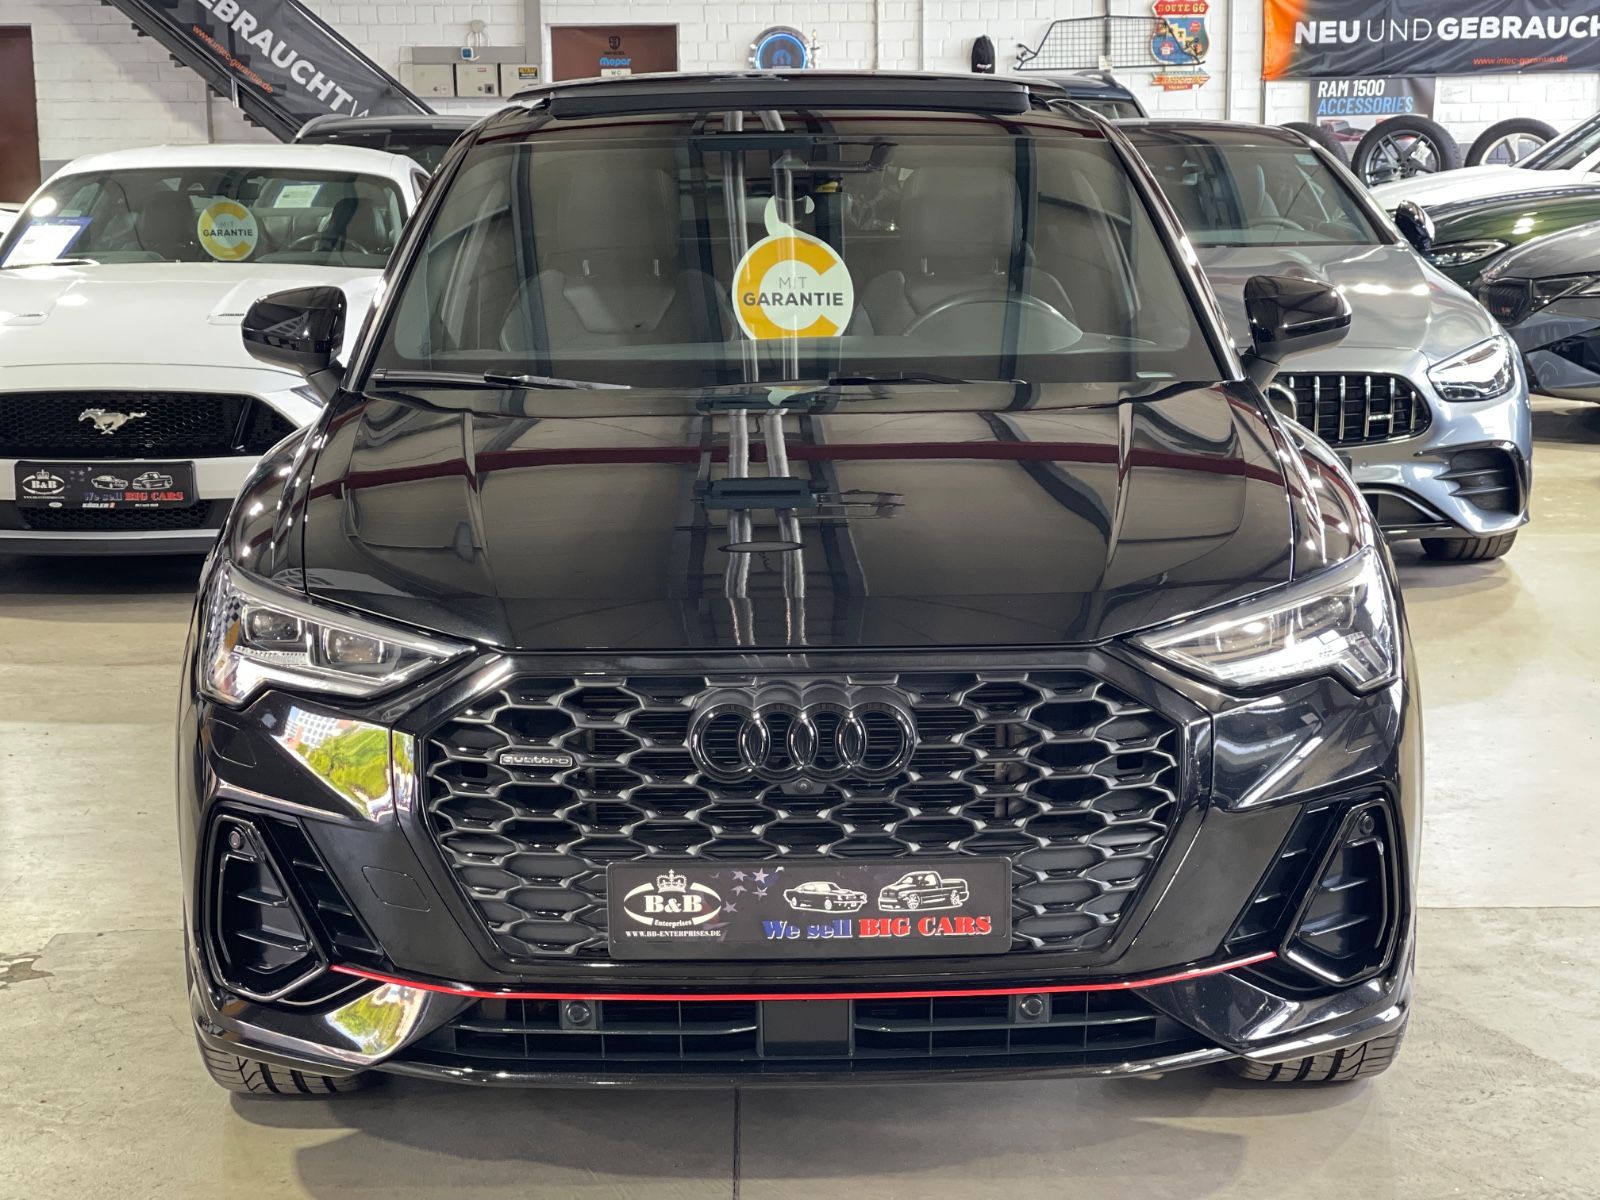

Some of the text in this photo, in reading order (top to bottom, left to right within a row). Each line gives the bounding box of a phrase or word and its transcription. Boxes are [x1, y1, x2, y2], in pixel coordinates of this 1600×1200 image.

[1192, 3, 1205, 13] 66
[1295, 20, 1360, 44] NEU
[1367, 18, 1432, 42] UND
[1317, 79, 1385, 98] RAM 1500
[1317, 96, 1414, 114] ACCESSORIES
[203, 229, 253, 237] GARANTIE
[778, 276, 808, 289] MIT
[743, 292, 843, 306] GARANTIE
[31, 480, 57, 489] B&B
[124, 492, 148, 501] BIG
[151, 491, 184, 501] CARS
[502, 755, 569, 764] quattro
[644, 895, 703, 913] B&B
[654, 919, 692, 928] Enterprises
[762, 916, 992, 939] We sell BIG CARS
